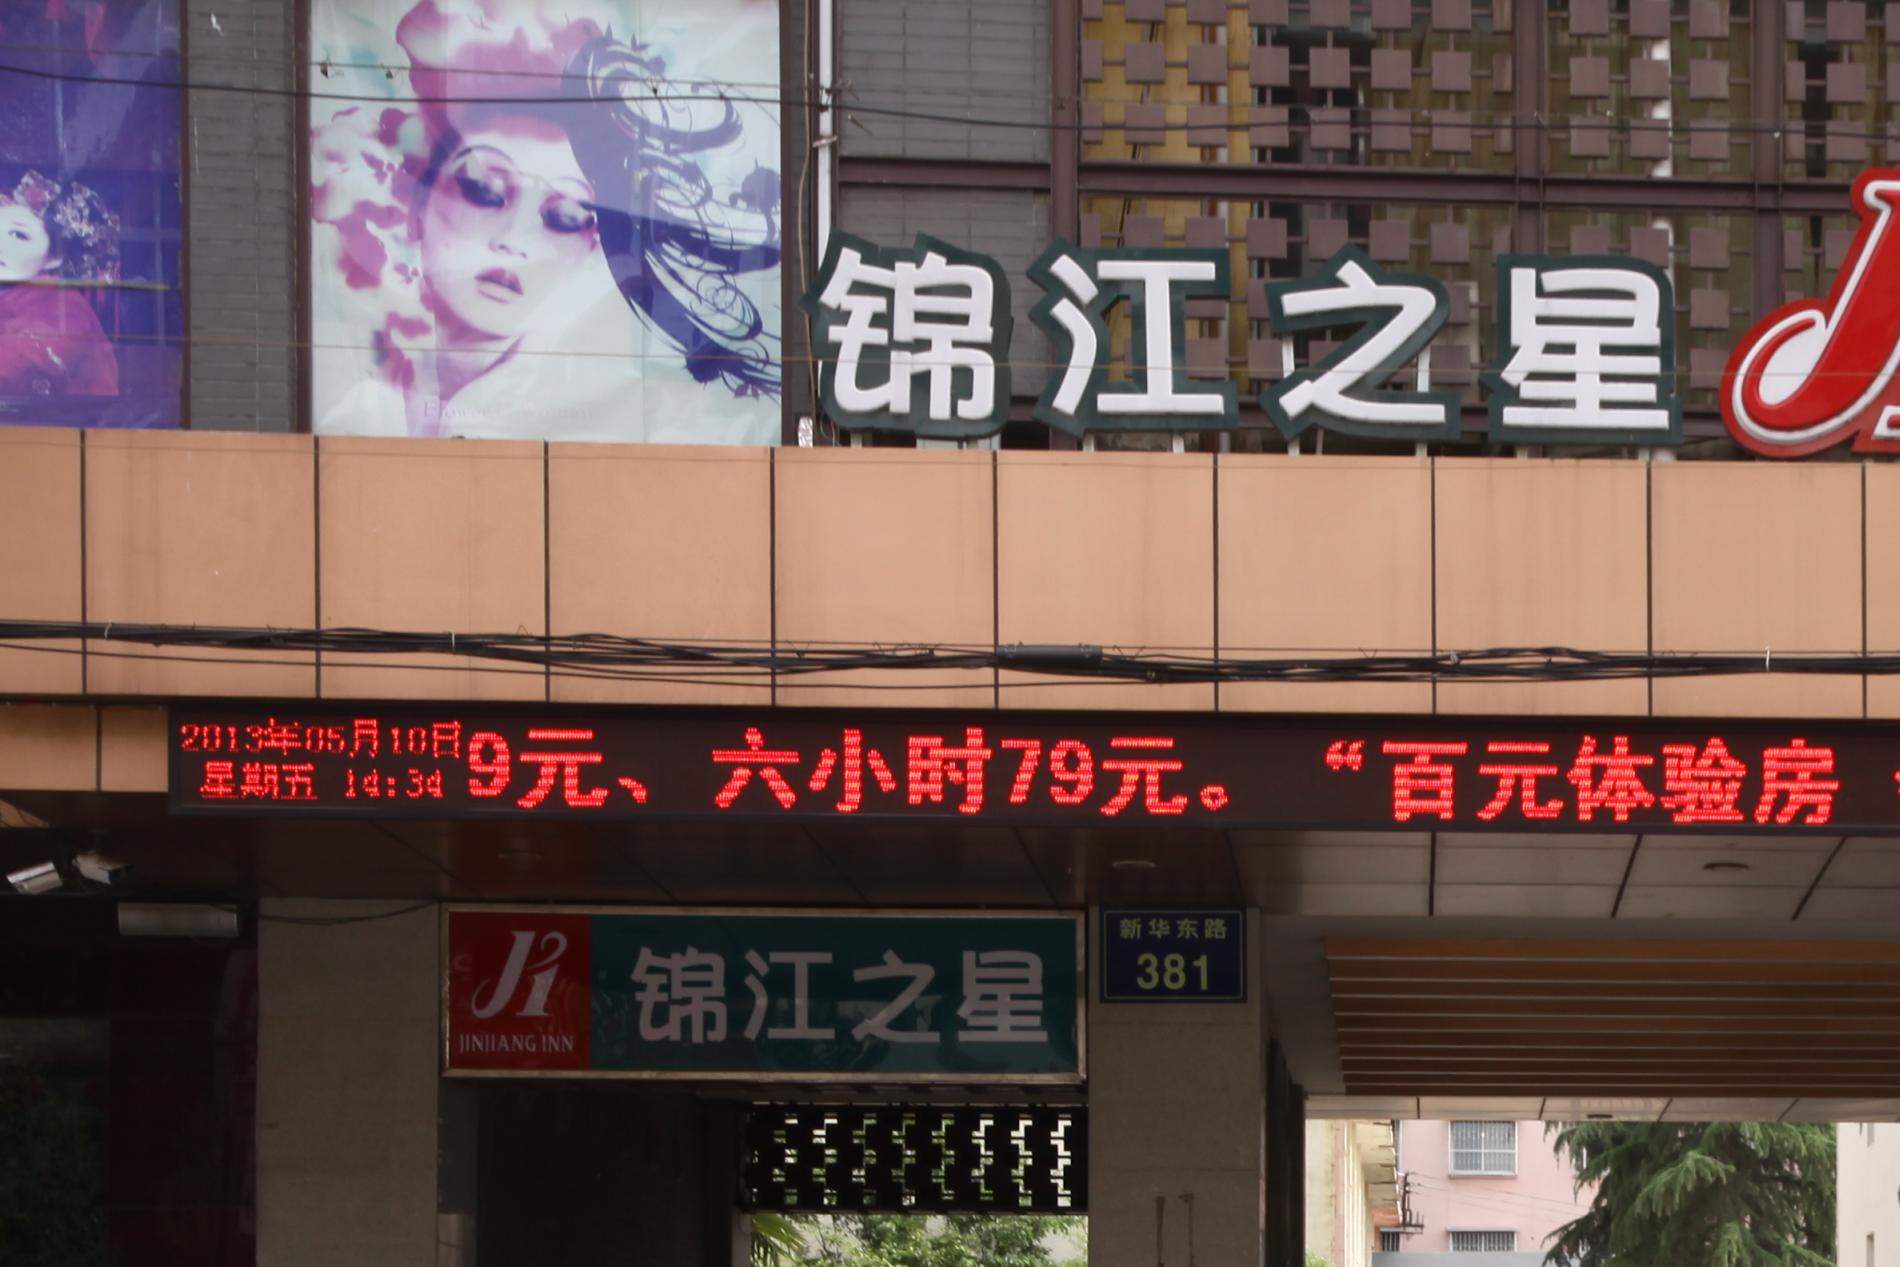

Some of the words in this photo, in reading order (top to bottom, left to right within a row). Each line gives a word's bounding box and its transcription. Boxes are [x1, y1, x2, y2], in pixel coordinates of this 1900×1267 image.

[817, 244, 1671, 430] 锦江之星
[180, 717, 462, 759] 2013年05月10日
[199, 761, 319, 800] 星期五
[345, 767, 444, 799] 14:34
[1119, 918, 1228, 940] 新华东路
[1136, 952, 1209, 991] 381
[630, 944, 1049, 1045] 锦江之星
[459, 1034, 537, 1054] JINJIANG
[542, 1034, 575, 1053] INN
